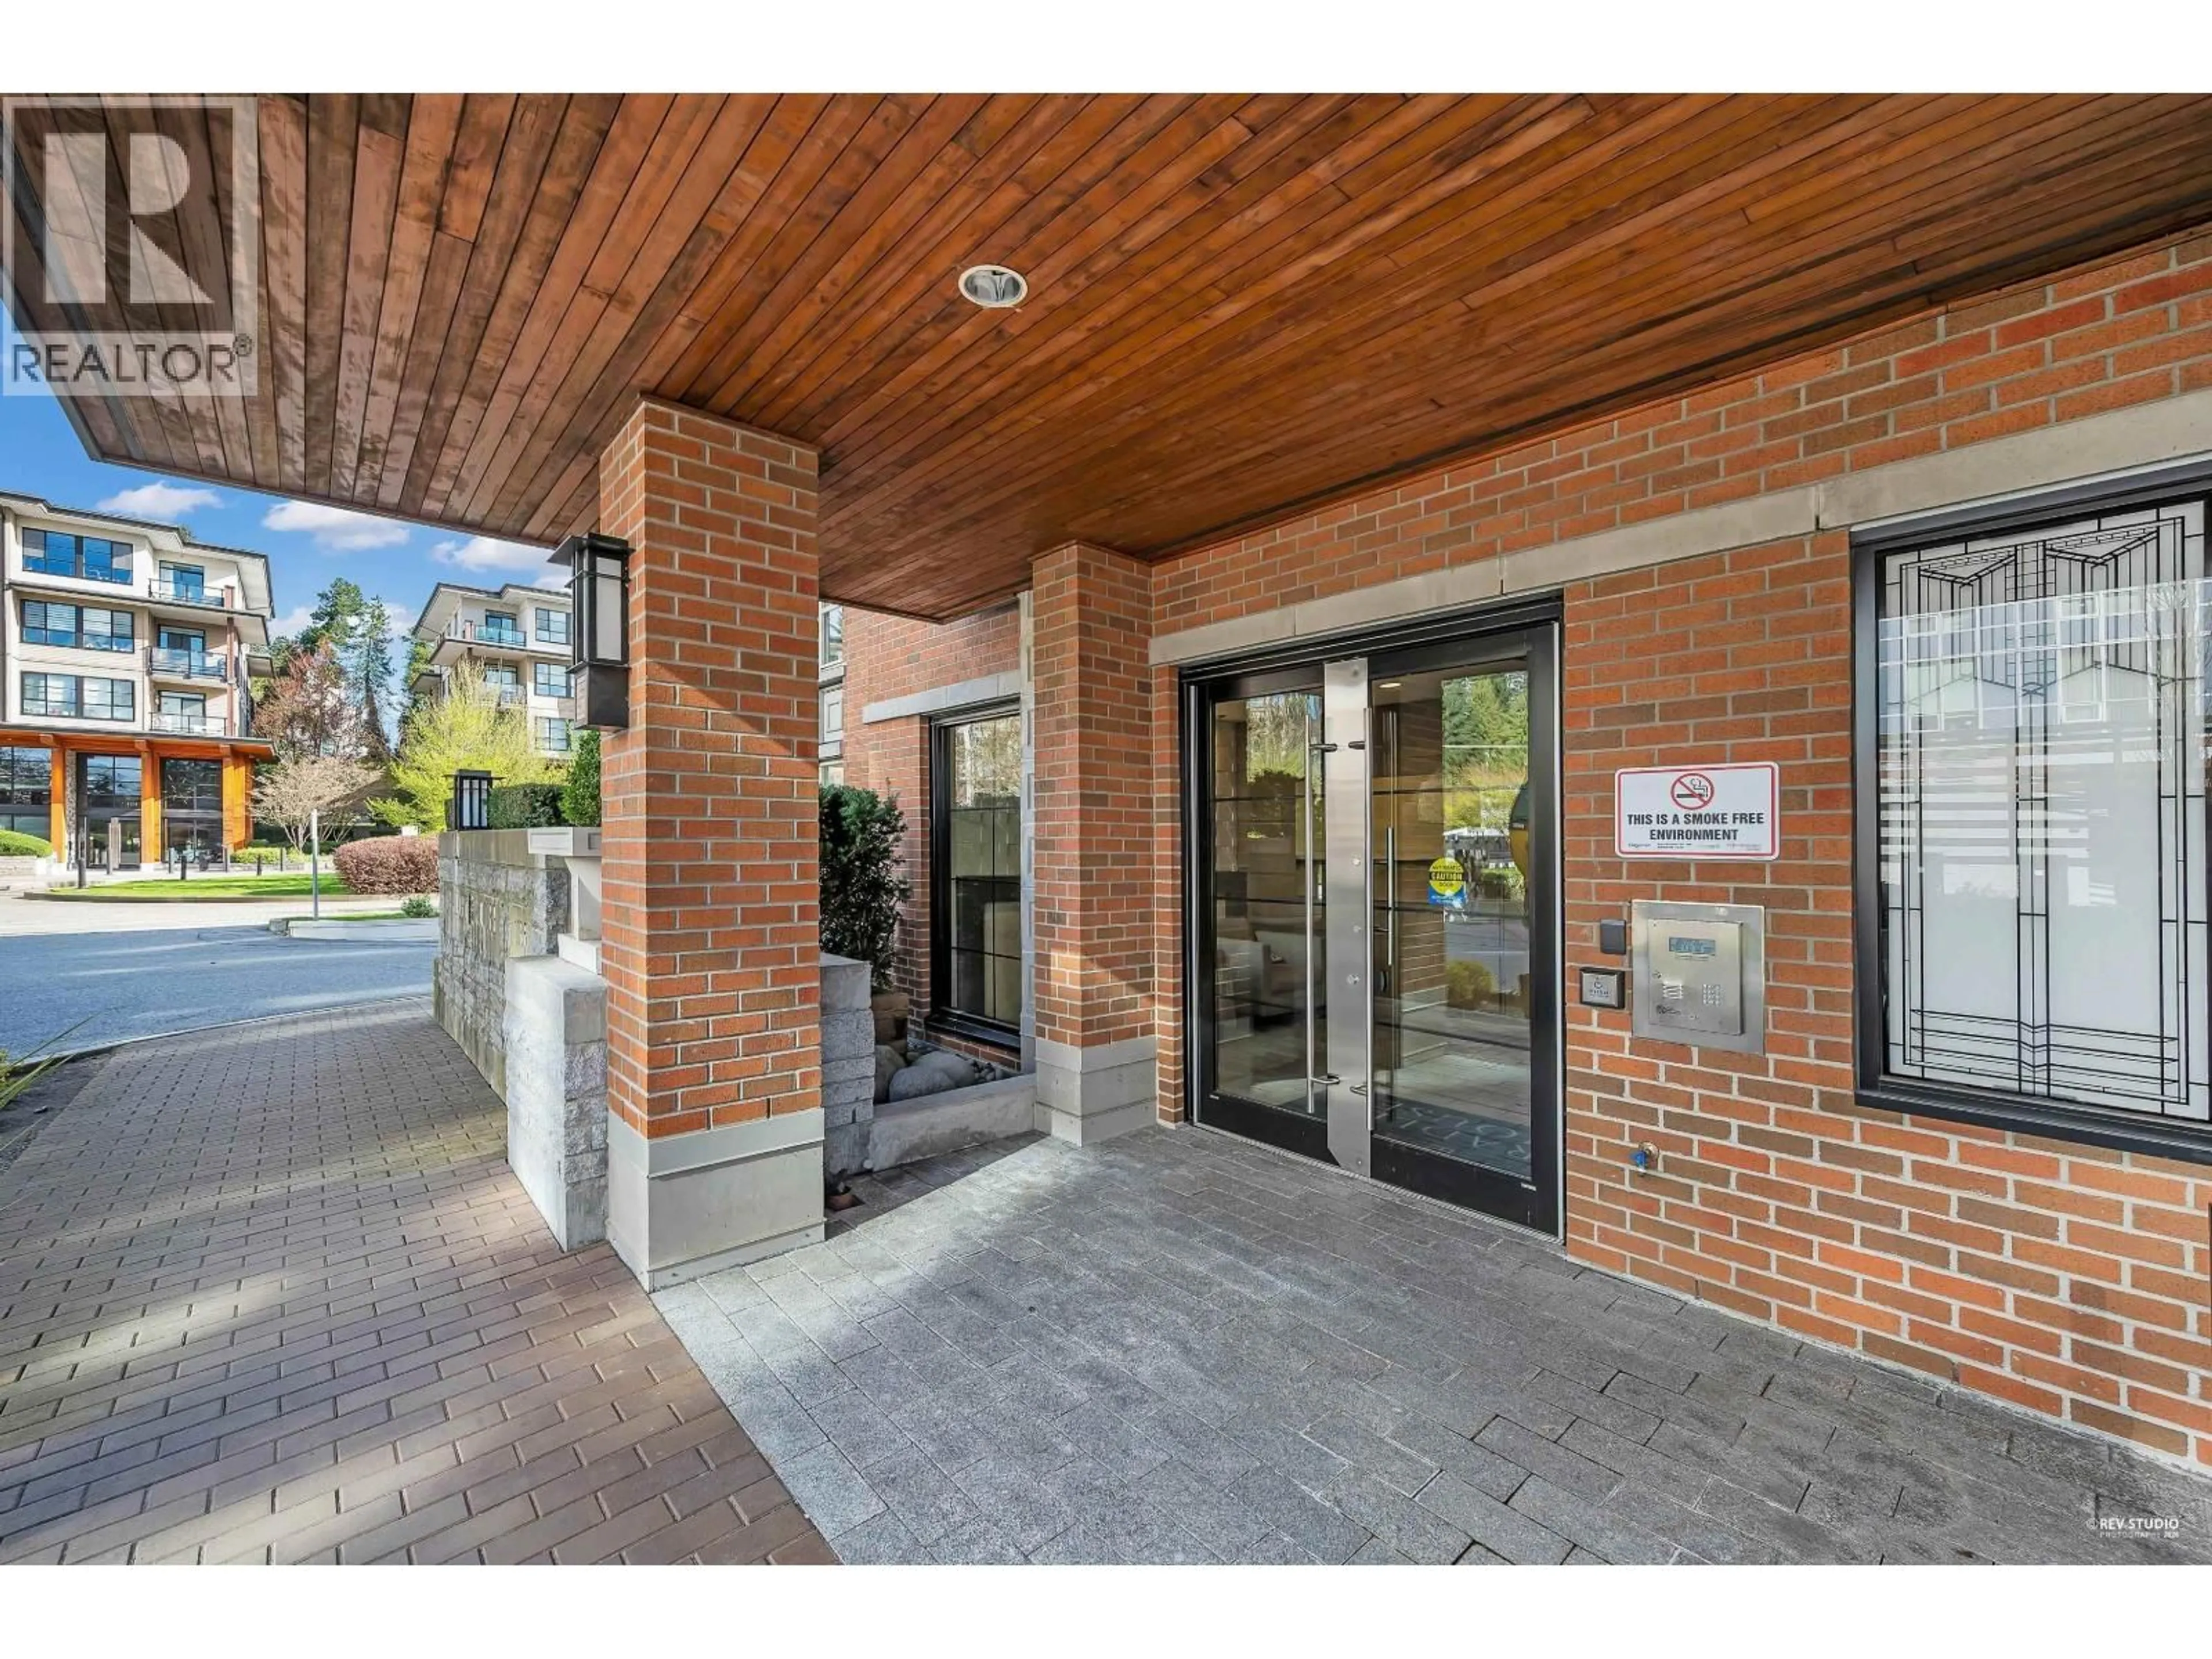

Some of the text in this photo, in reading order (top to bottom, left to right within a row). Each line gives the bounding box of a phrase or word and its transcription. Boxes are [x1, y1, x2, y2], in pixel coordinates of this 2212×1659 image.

[1627, 812, 1764, 825] THIS IS A SMOKE FREE
[1649, 829, 1738, 840] ENVIRONMENT
[1431, 872, 1462, 880] CAUTION
